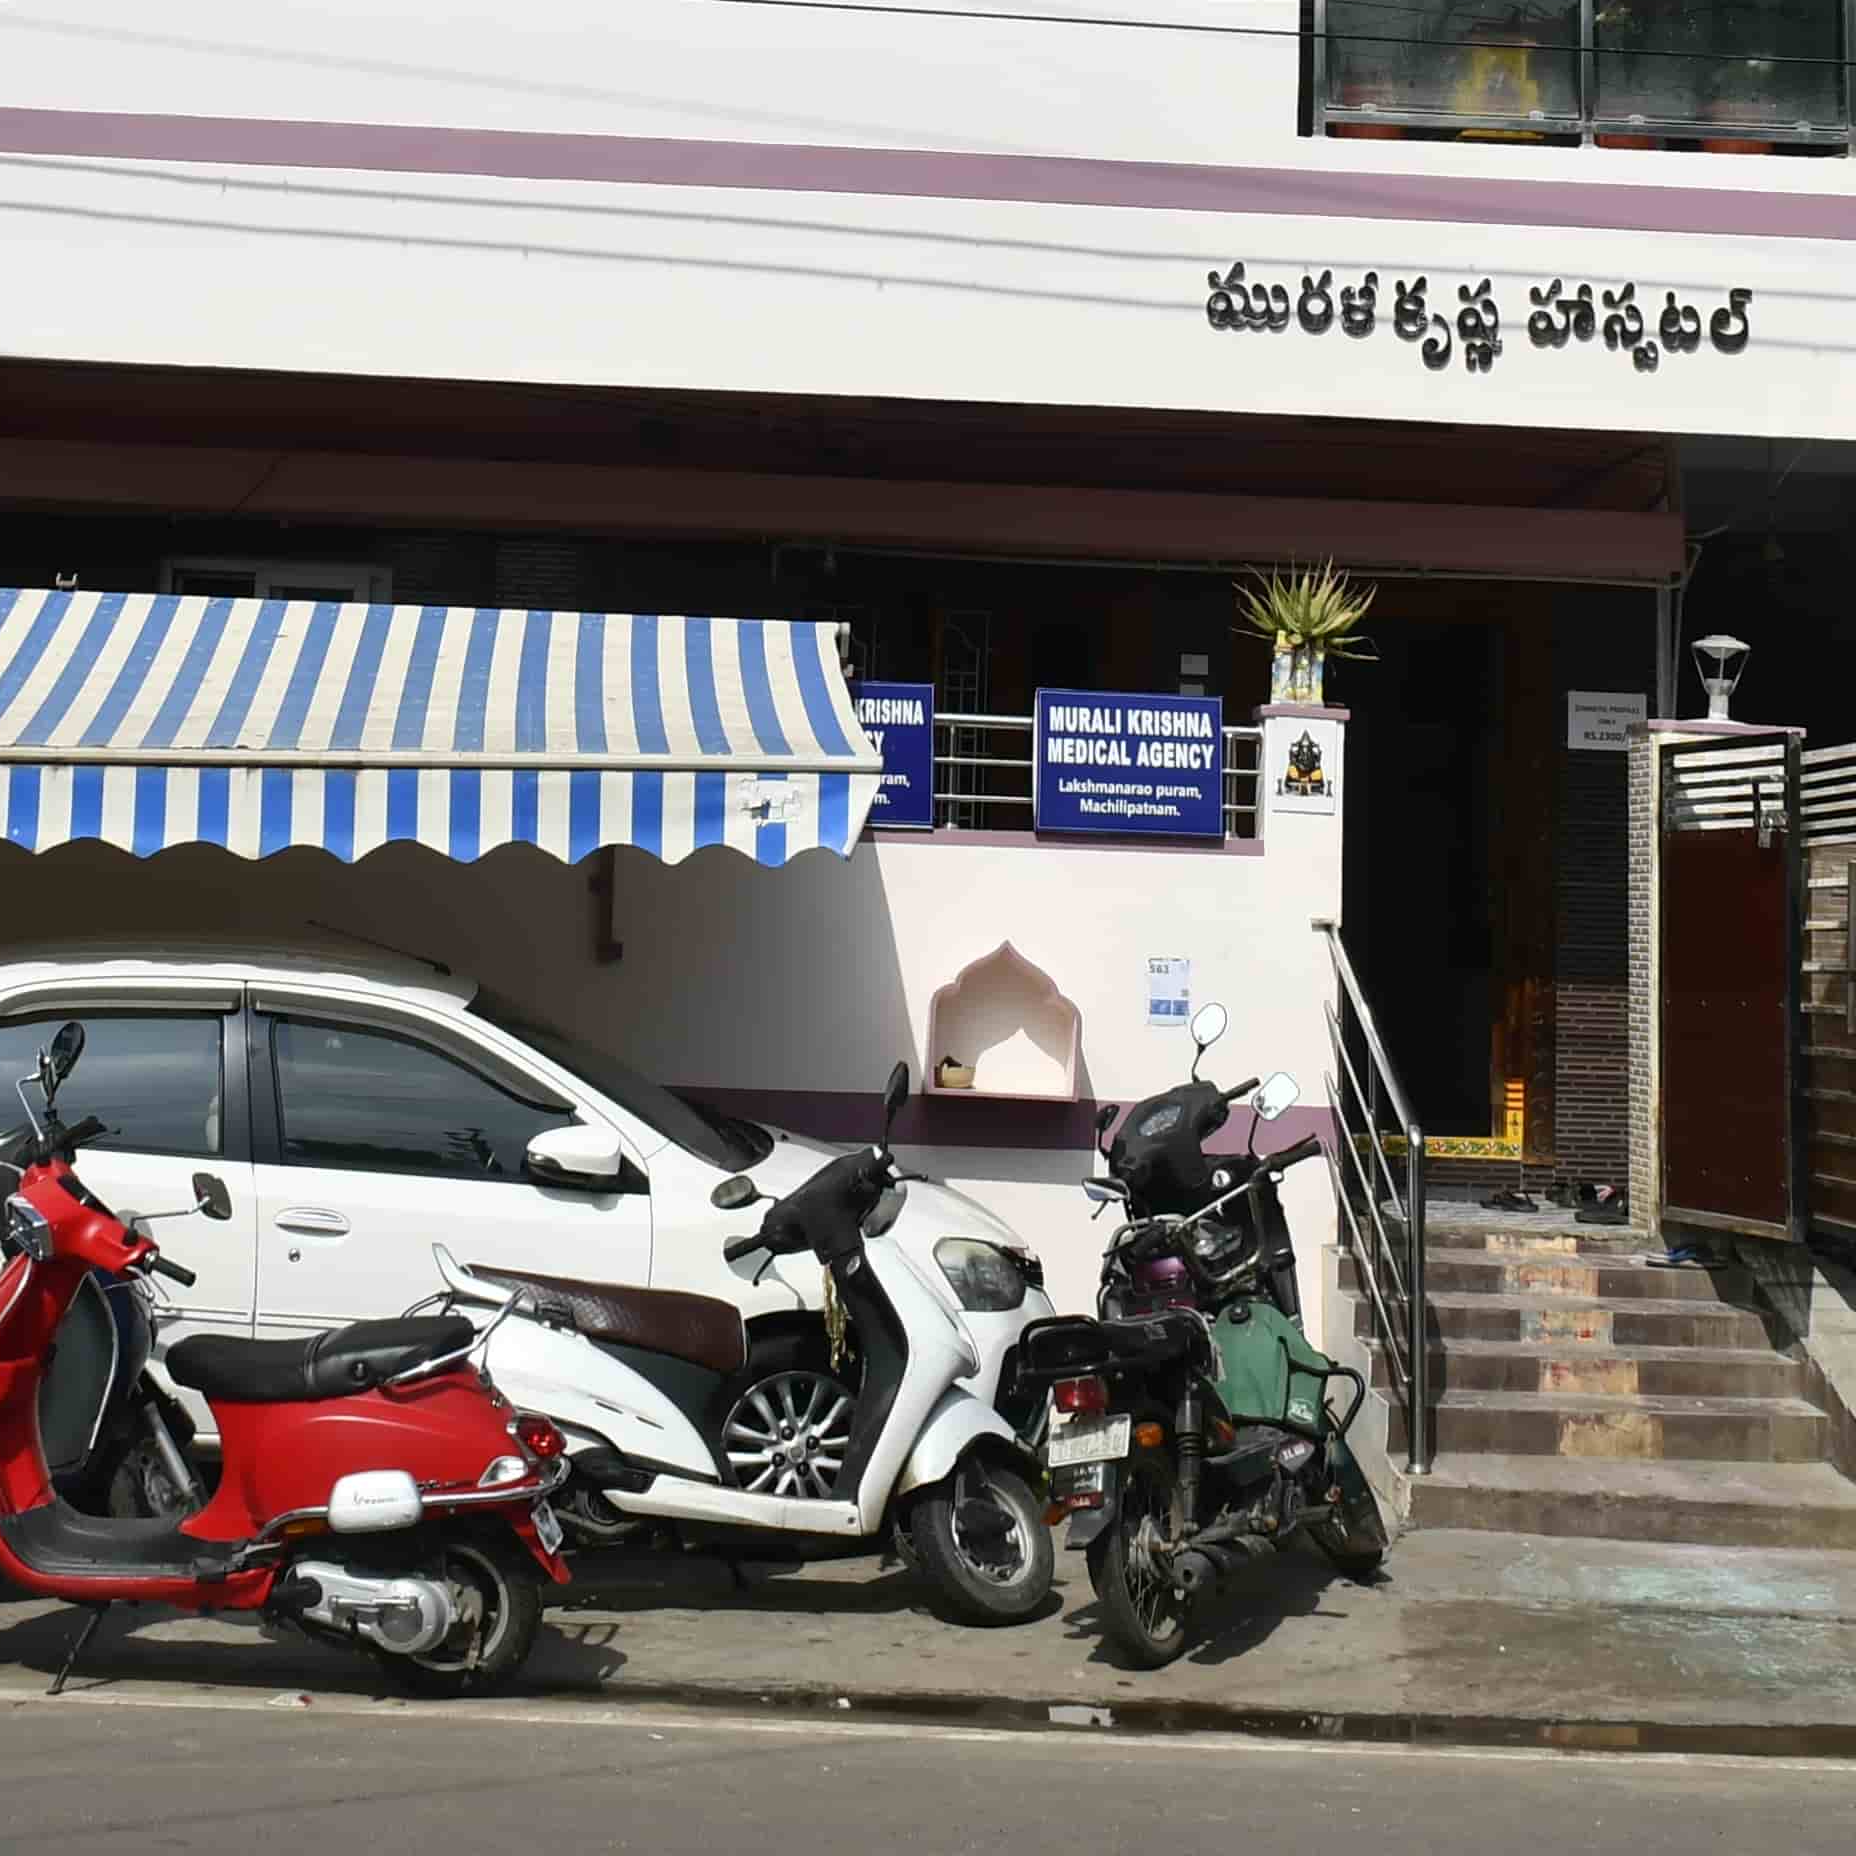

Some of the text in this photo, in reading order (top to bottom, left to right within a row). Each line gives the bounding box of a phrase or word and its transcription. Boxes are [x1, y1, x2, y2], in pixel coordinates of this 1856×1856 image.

[1048, 705, 1213, 738] MURALI KRISHNA
[1047, 737, 1215, 770] MEDICAL AGENCY
[1079, 797, 1181, 818] Machilipatnam.
